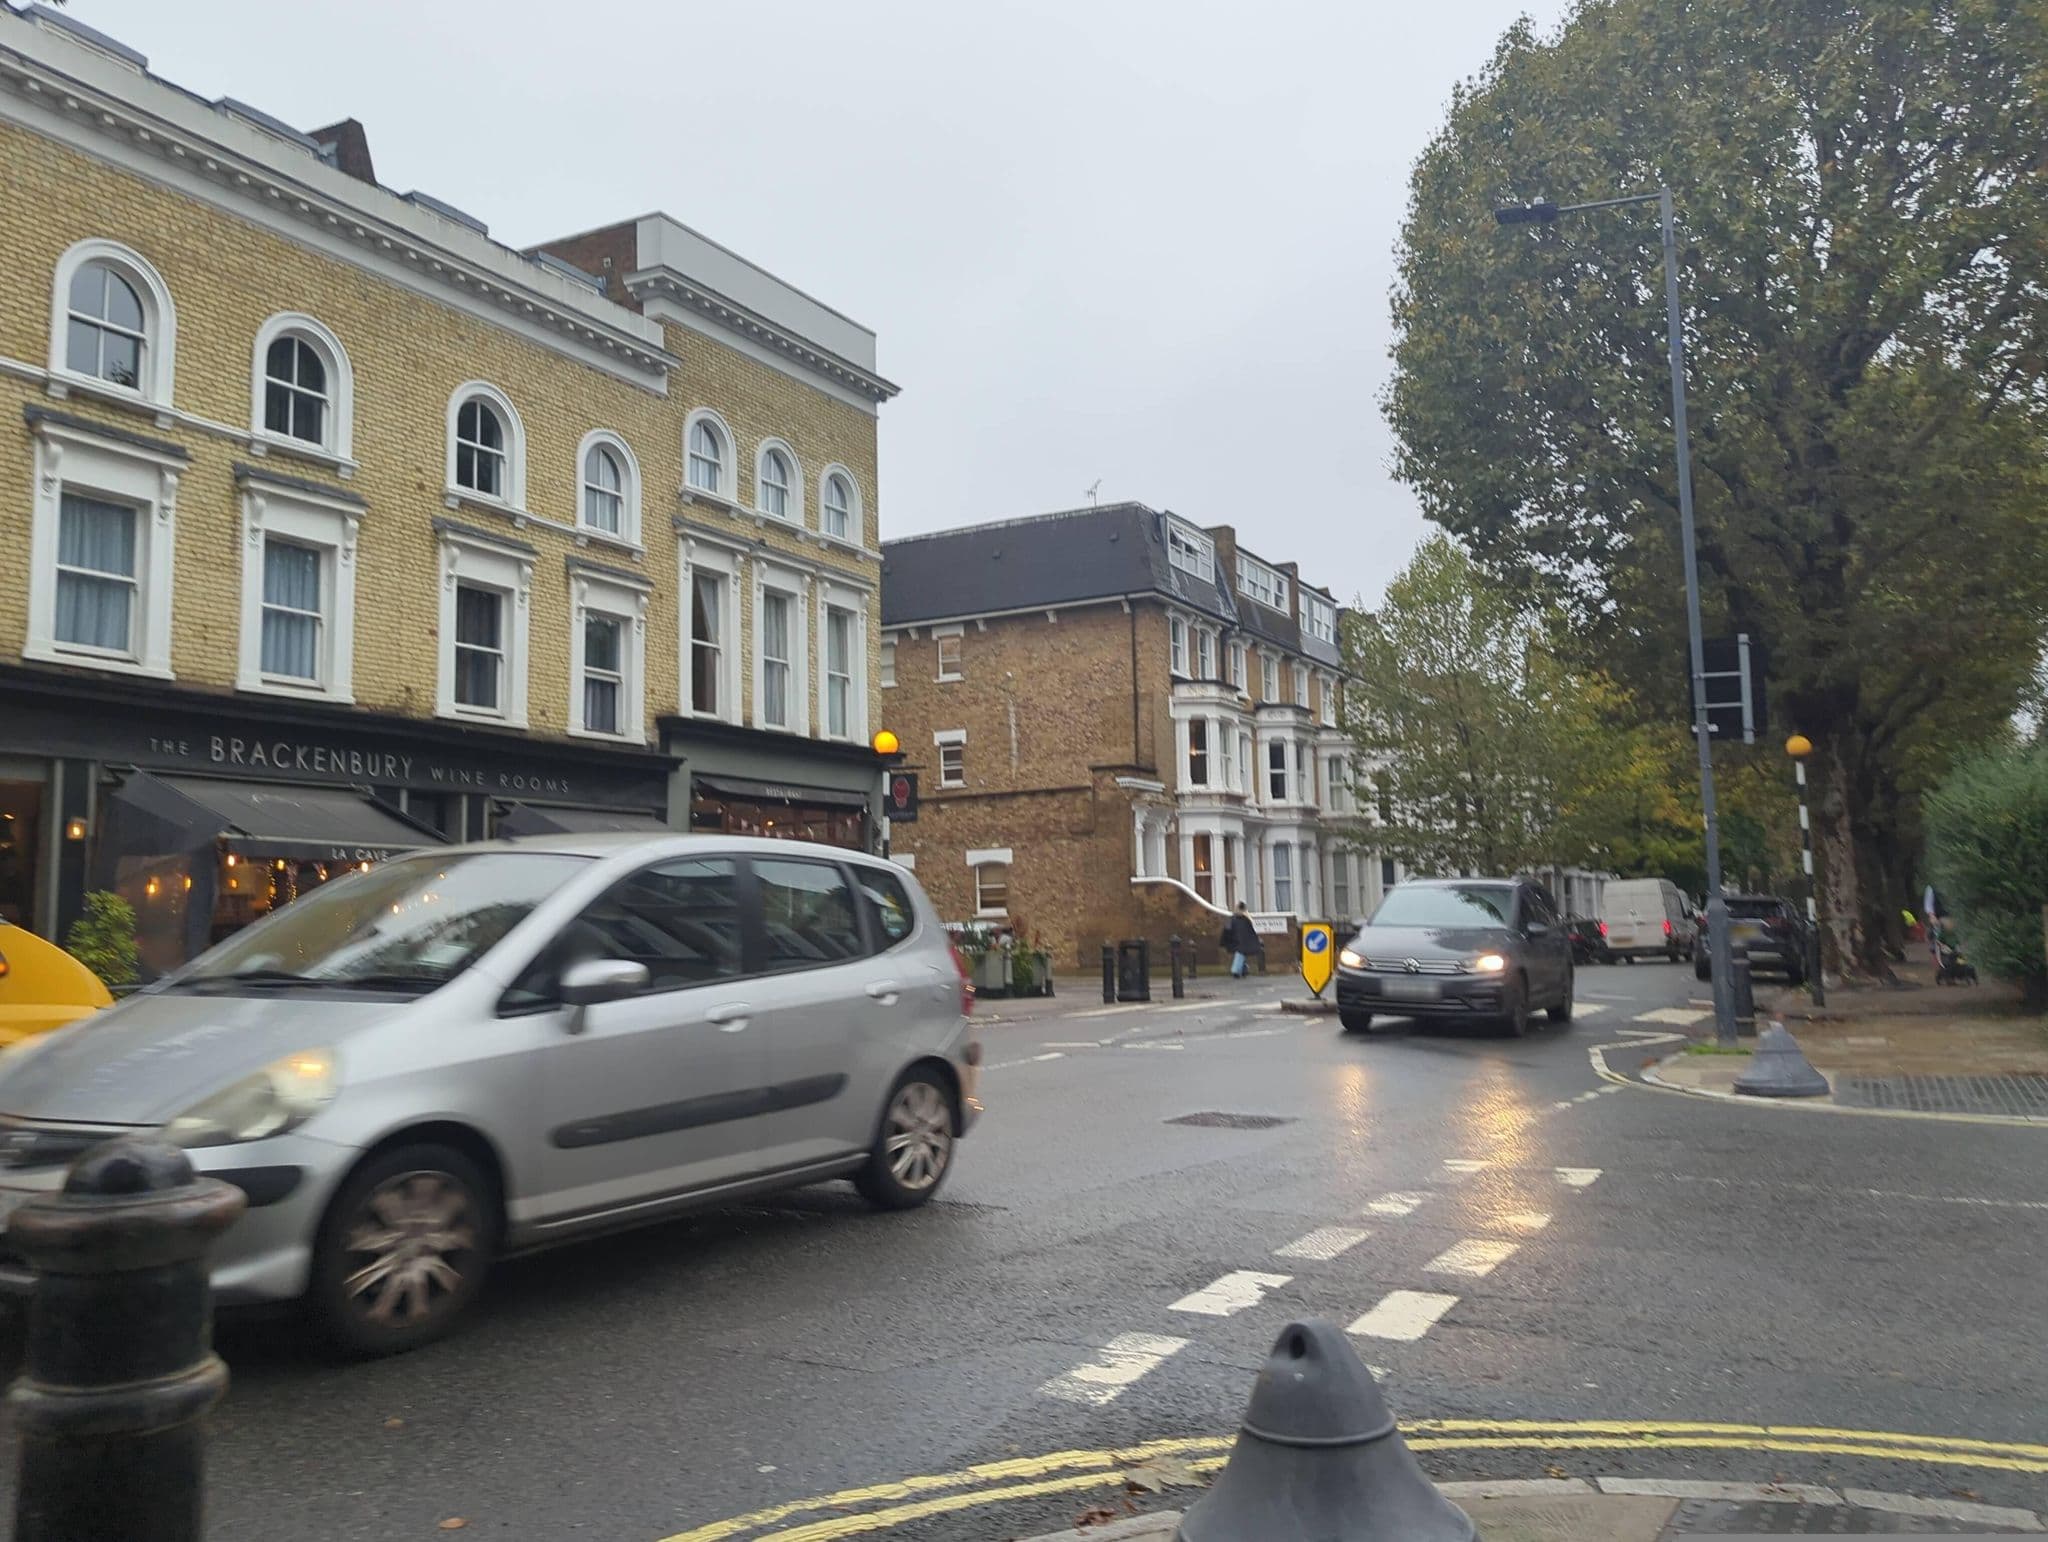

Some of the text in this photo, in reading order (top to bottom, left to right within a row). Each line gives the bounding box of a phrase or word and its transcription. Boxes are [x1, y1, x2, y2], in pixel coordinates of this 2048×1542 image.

[150, 736, 569, 793] THE BRACKENBURY WINE ROOMS
[331, 847, 389, 863] LA CAVE
